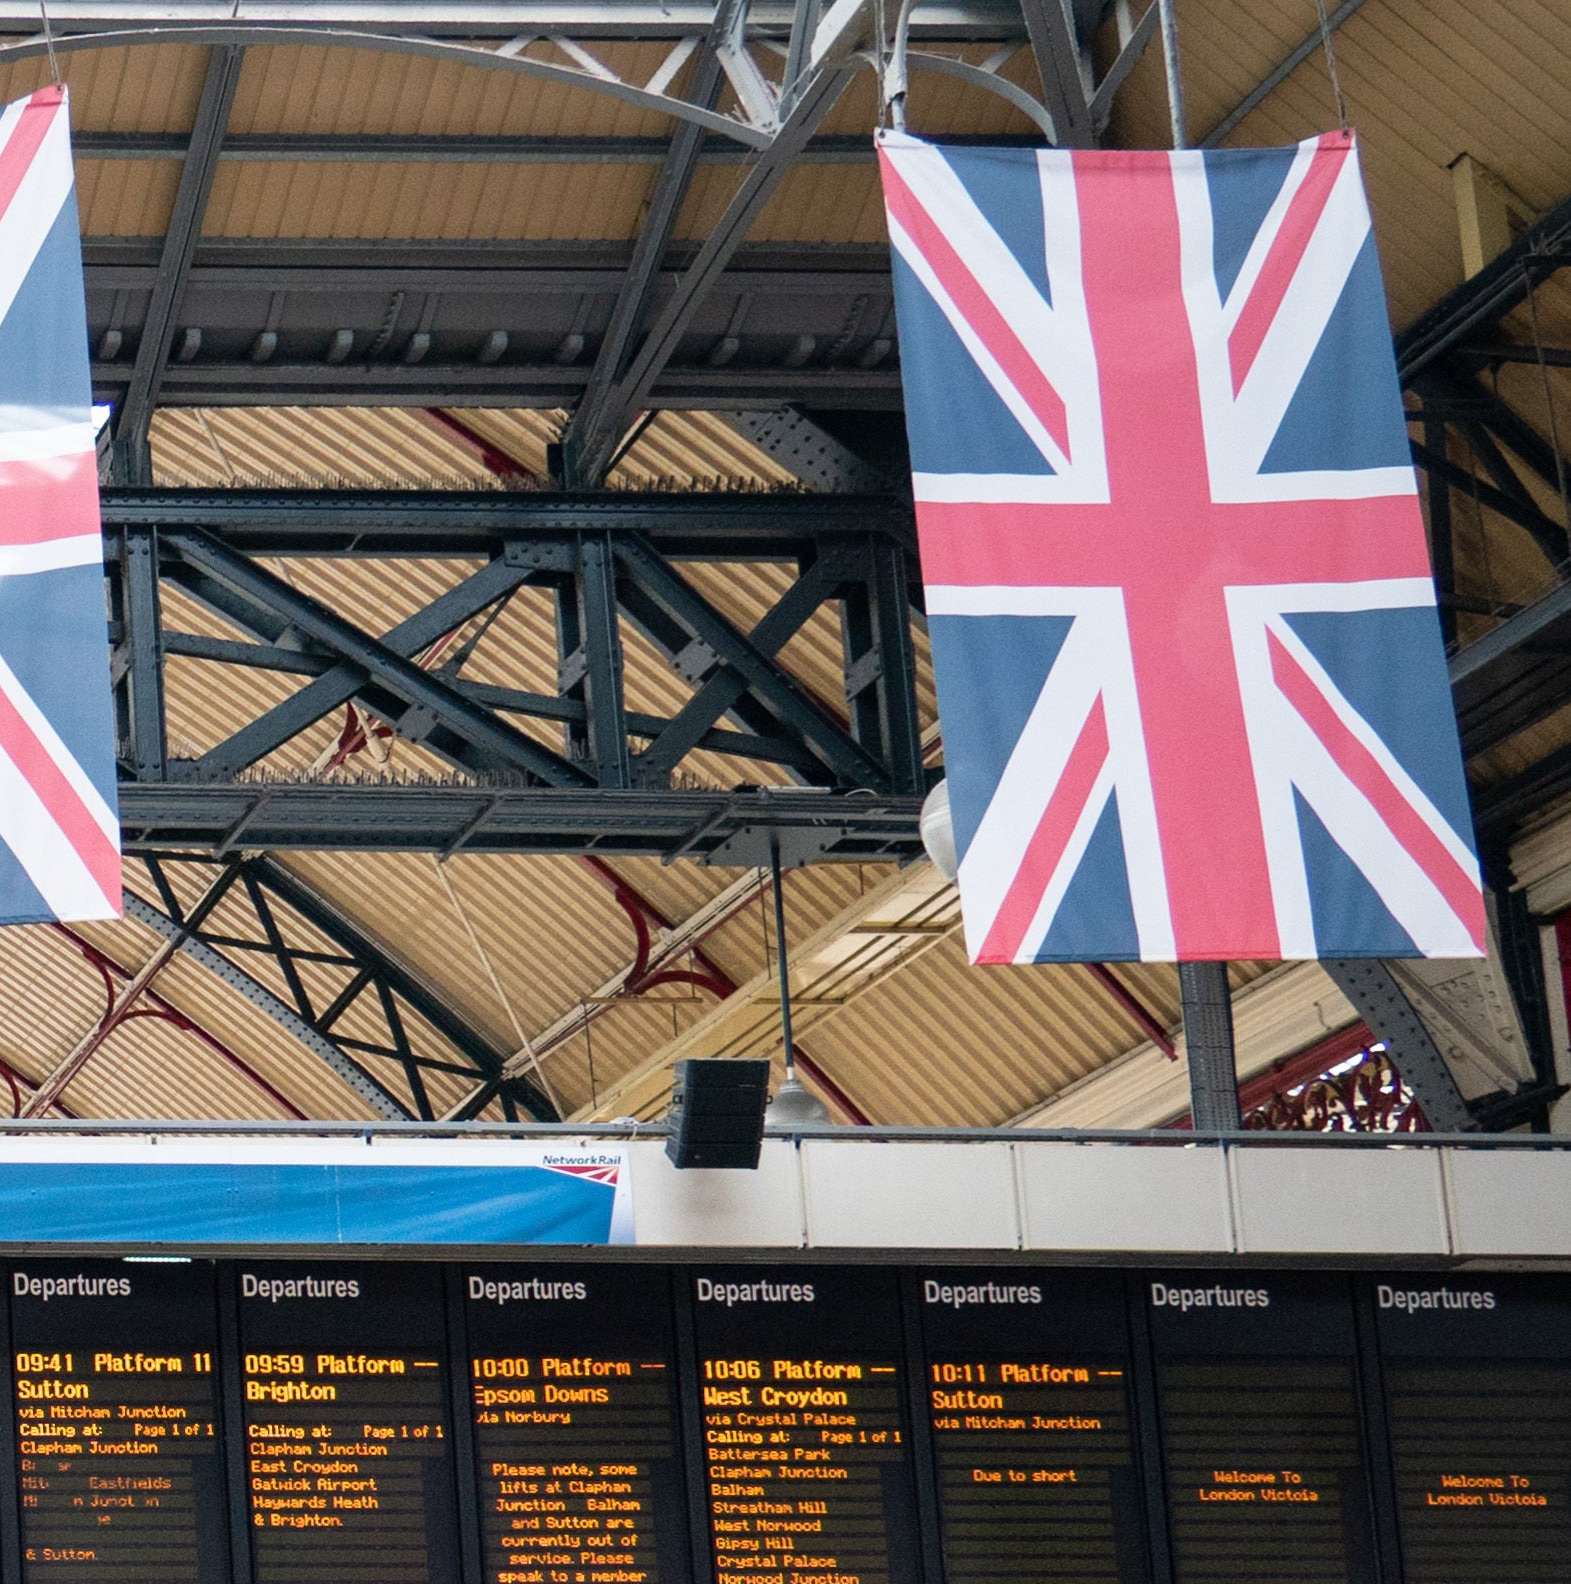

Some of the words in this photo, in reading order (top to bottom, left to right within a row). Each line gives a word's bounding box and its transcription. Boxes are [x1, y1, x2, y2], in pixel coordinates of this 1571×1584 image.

[470, 1277, 586, 1304] Departures
[1378, 1286, 1495, 1313] Departures
[16, 1353, 73, 1373] 09:41
[94, 1352, 183, 1373] Platform
[193, 1353, 211, 1372] 11
[244, 1354, 305, 1374] 09:59
[316, 1354, 405, 1375] Platform
[704, 1360, 761, 1380] 10:06
[772, 1360, 862, 1380] Platform
[932, 1363, 986, 1383] 10:11
[1000, 1363, 1089, 1383] Platform
[17, 1379, 89, 1399] Sutton
[246, 1380, 336, 1403] Brighton
[703, 1386, 753, 1406] West
[760, 1386, 848, 1409] Croydon
[932, 1390, 1003, 1409] Sutton
[1213, 1470, 1276, 1484] Welcome
[1281, 1470, 1302, 1484] To
[1198, 1488, 1256, 1501] London
